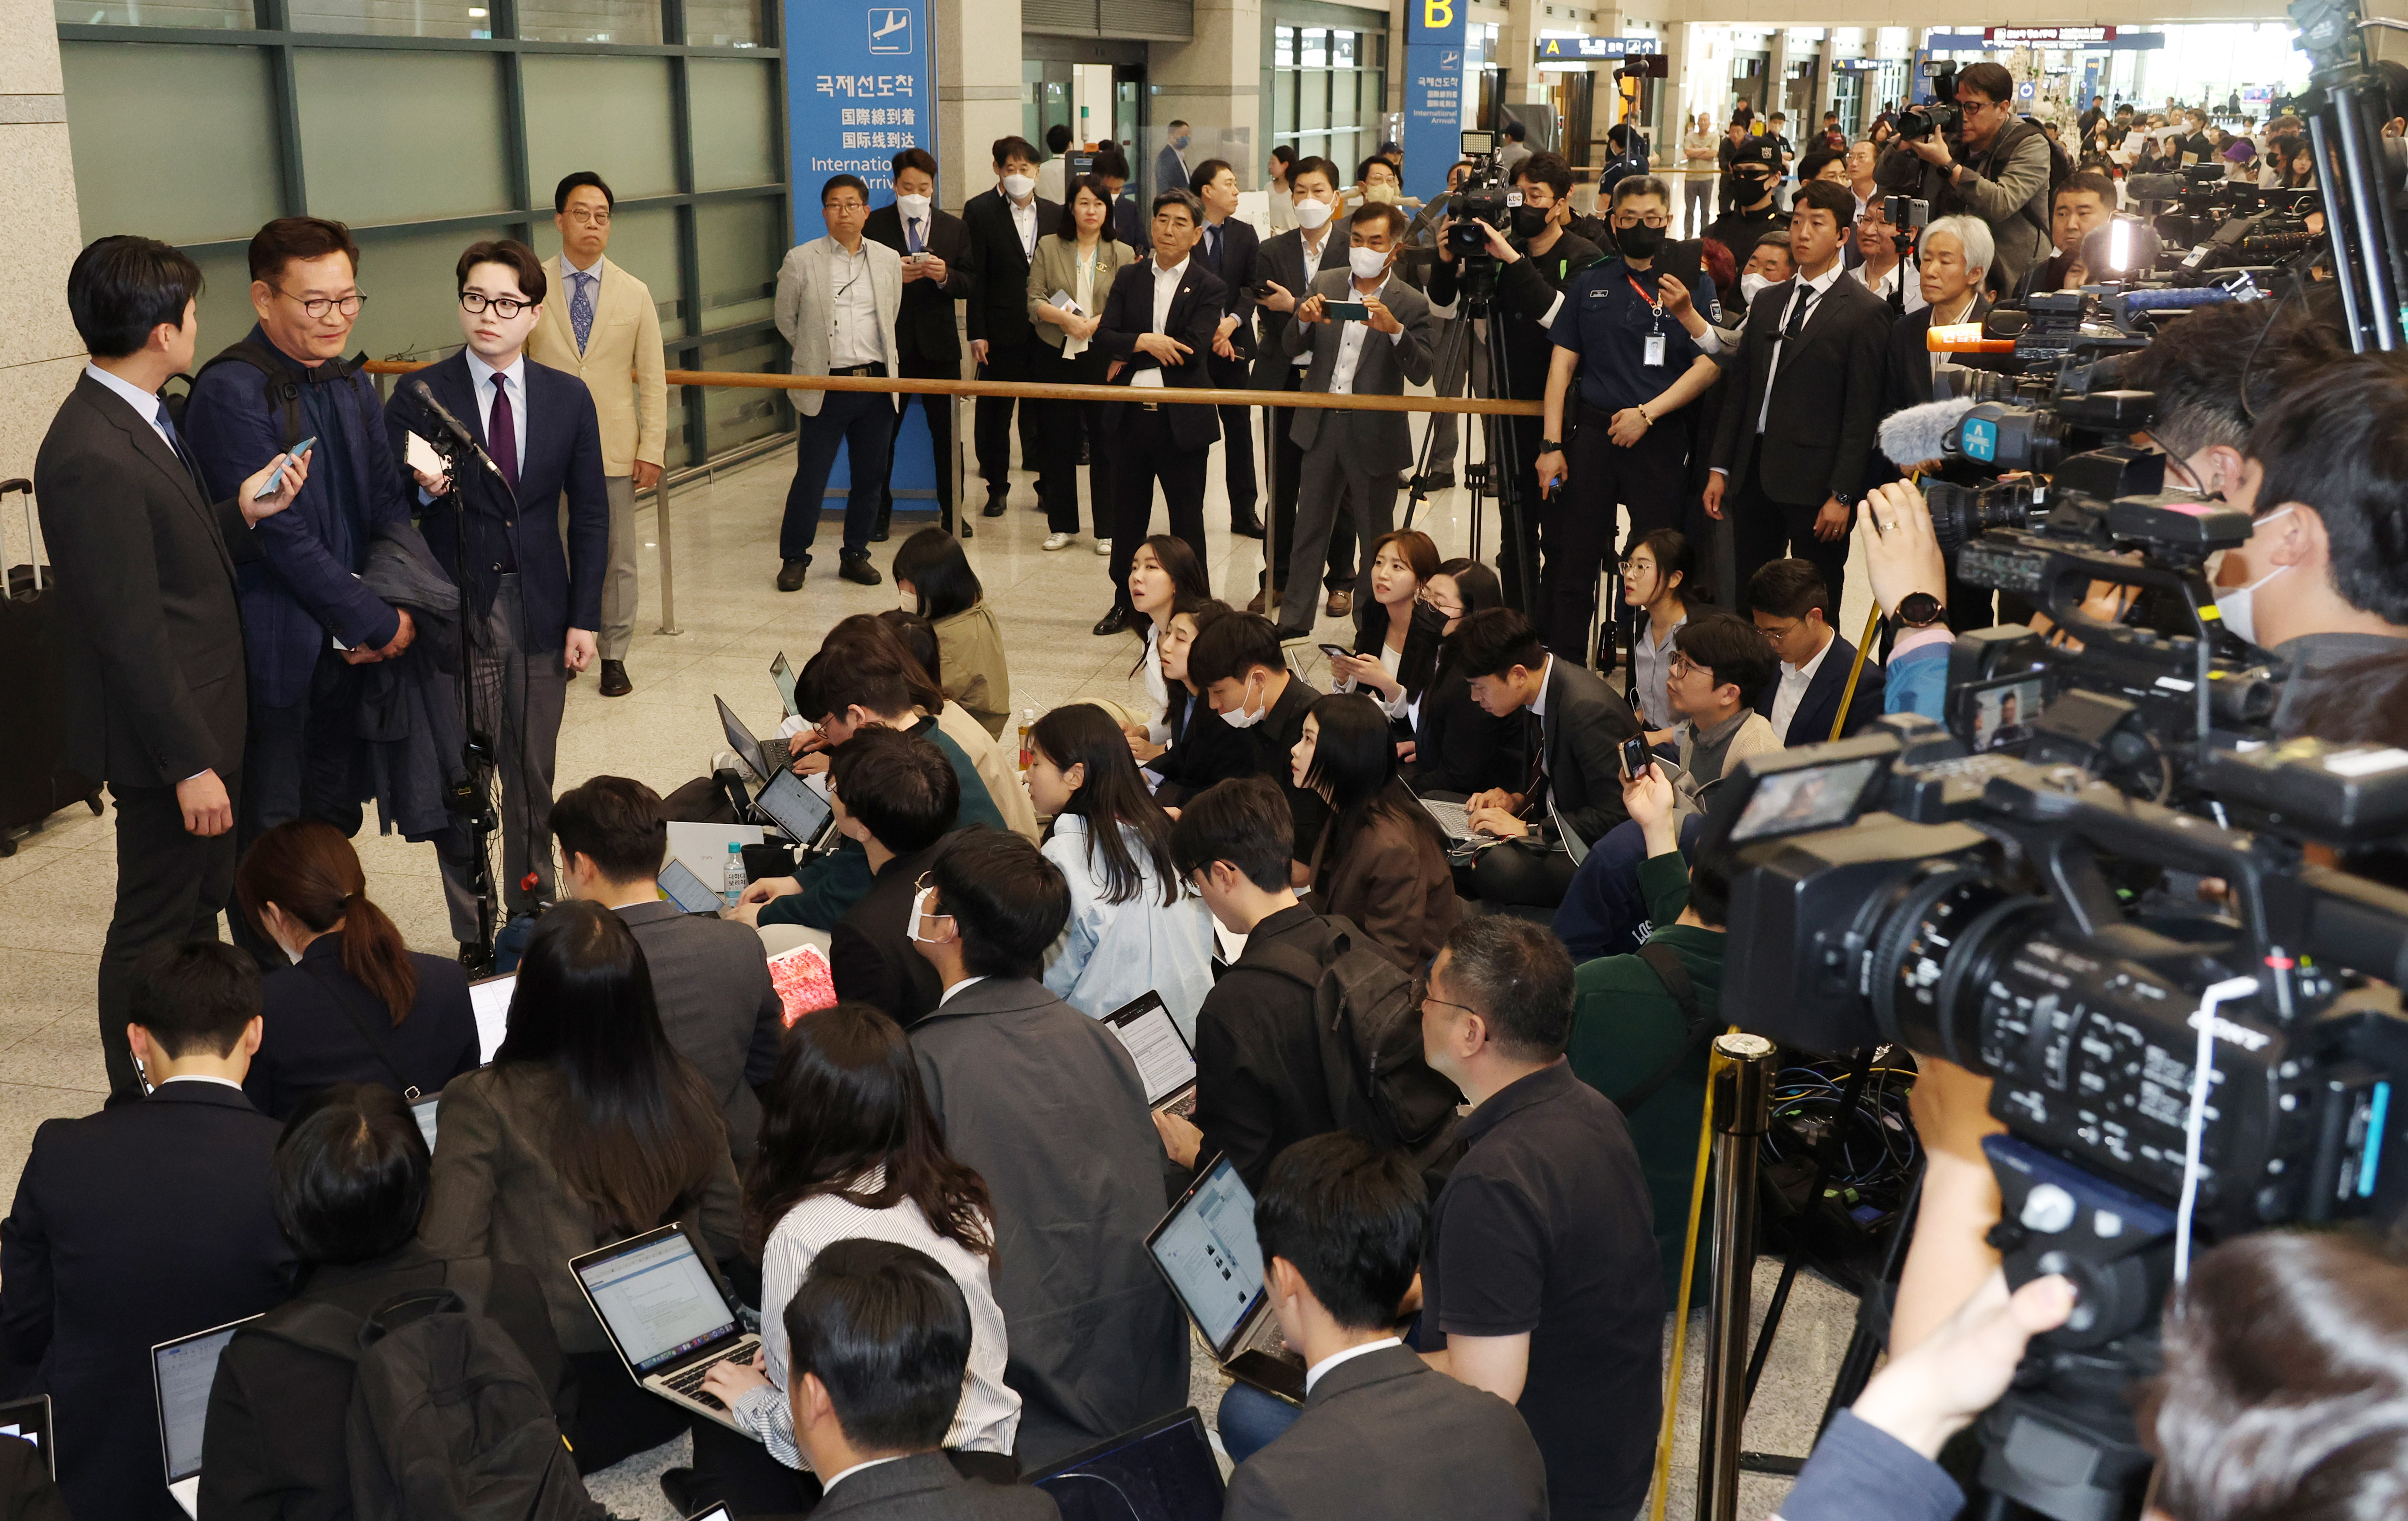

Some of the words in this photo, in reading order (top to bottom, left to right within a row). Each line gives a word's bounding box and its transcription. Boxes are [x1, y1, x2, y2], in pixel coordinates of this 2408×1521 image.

[1424, 0, 1454, 28] B
[1546, 40, 1560, 55] A
[1838, 60, 1846, 68] A
[816, 75, 914, 98] 국제선도착
[841, 108, 915, 126] 国際線到着
[842, 131, 915, 149] 国际线到达
[812, 157, 893, 172] Internatio
[859, 175, 894, 190] Arriv
[1941, 329, 1994, 343] 연합뉴
